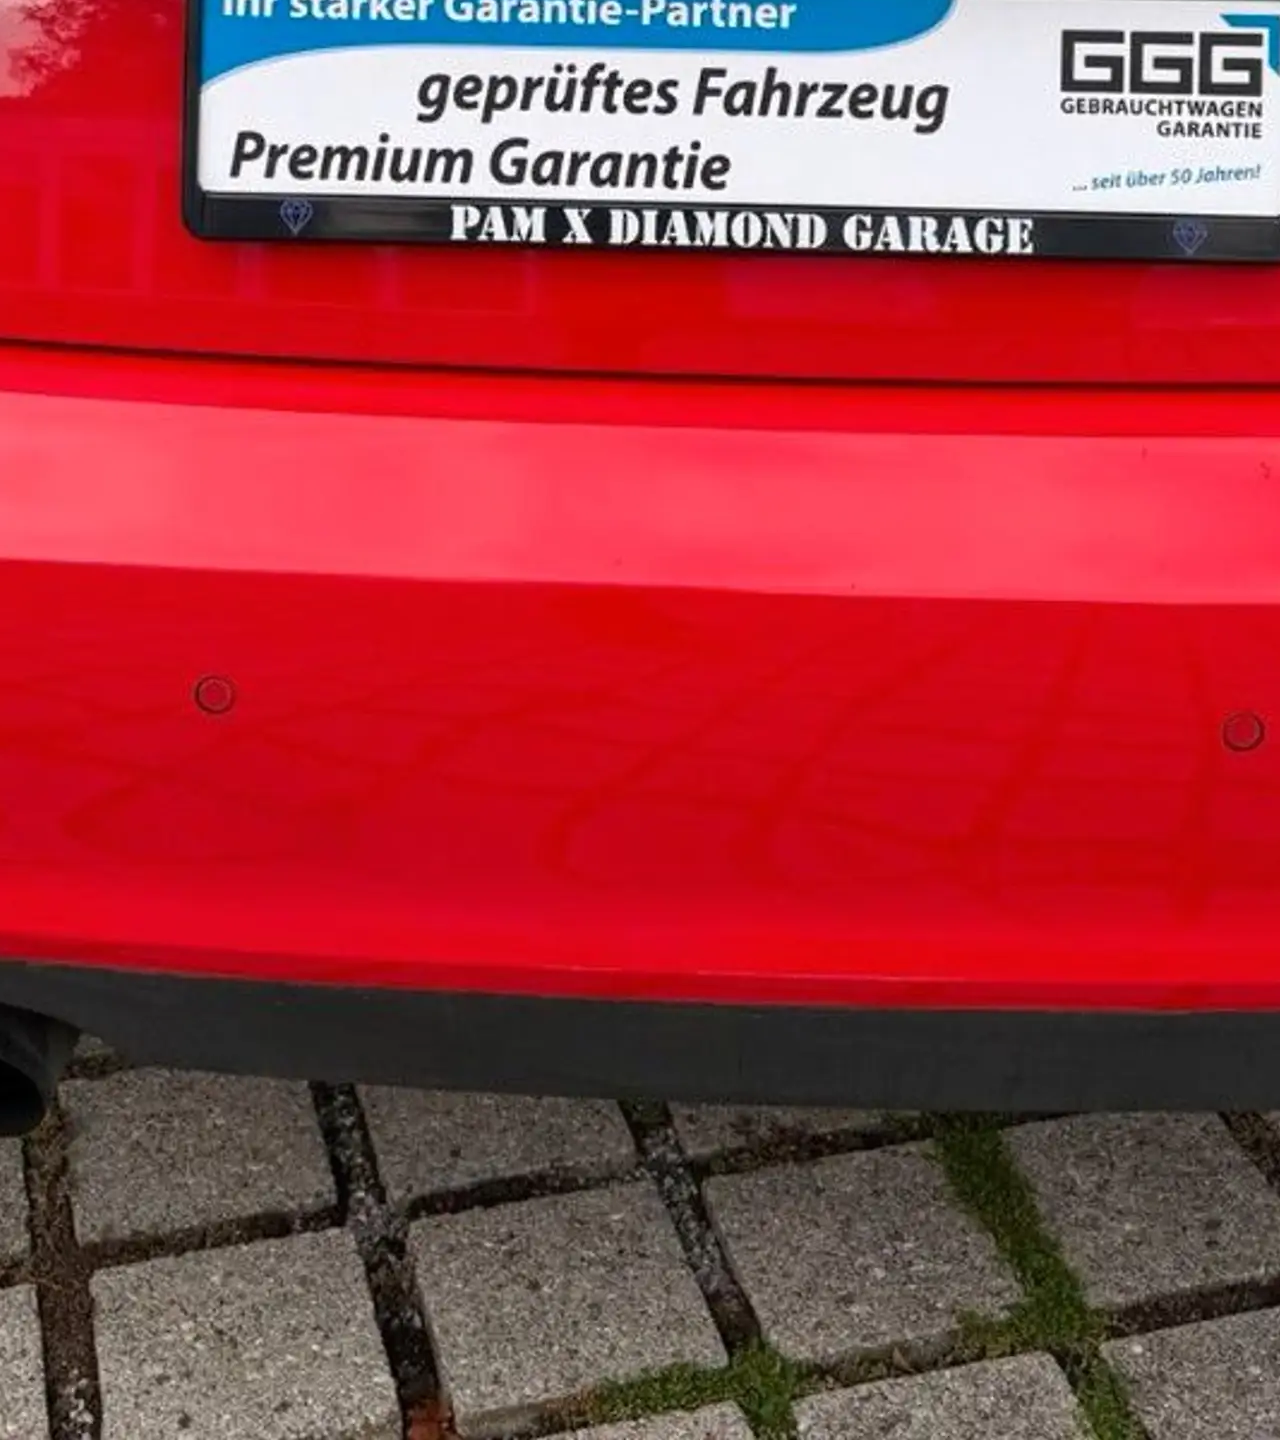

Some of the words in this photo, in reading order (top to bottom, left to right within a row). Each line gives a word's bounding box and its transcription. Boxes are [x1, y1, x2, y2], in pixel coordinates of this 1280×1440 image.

[1060, 29, 1264, 97] GGG
[416, 63, 679, 125] geprüftes
[692, 66, 951, 134] Fahrzeug
[1060, 98, 1264, 118] GEBRAUCHTWAGEN
[1156, 121, 1263, 139] GARANTIE
[229, 130, 475, 186] Premium
[489, 136, 732, 191] Garantie
[1091, 173, 1123, 190] seit
[1126, 170, 1166, 188] über
[1170, 167, 1193, 185] 50
[1195, 164, 1262, 185] Jahren!
[450, 204, 546, 243] PAM
[563, 208, 592, 245] X
[609, 209, 825, 250] DIAMOND
[844, 213, 1034, 254] GARAGE
